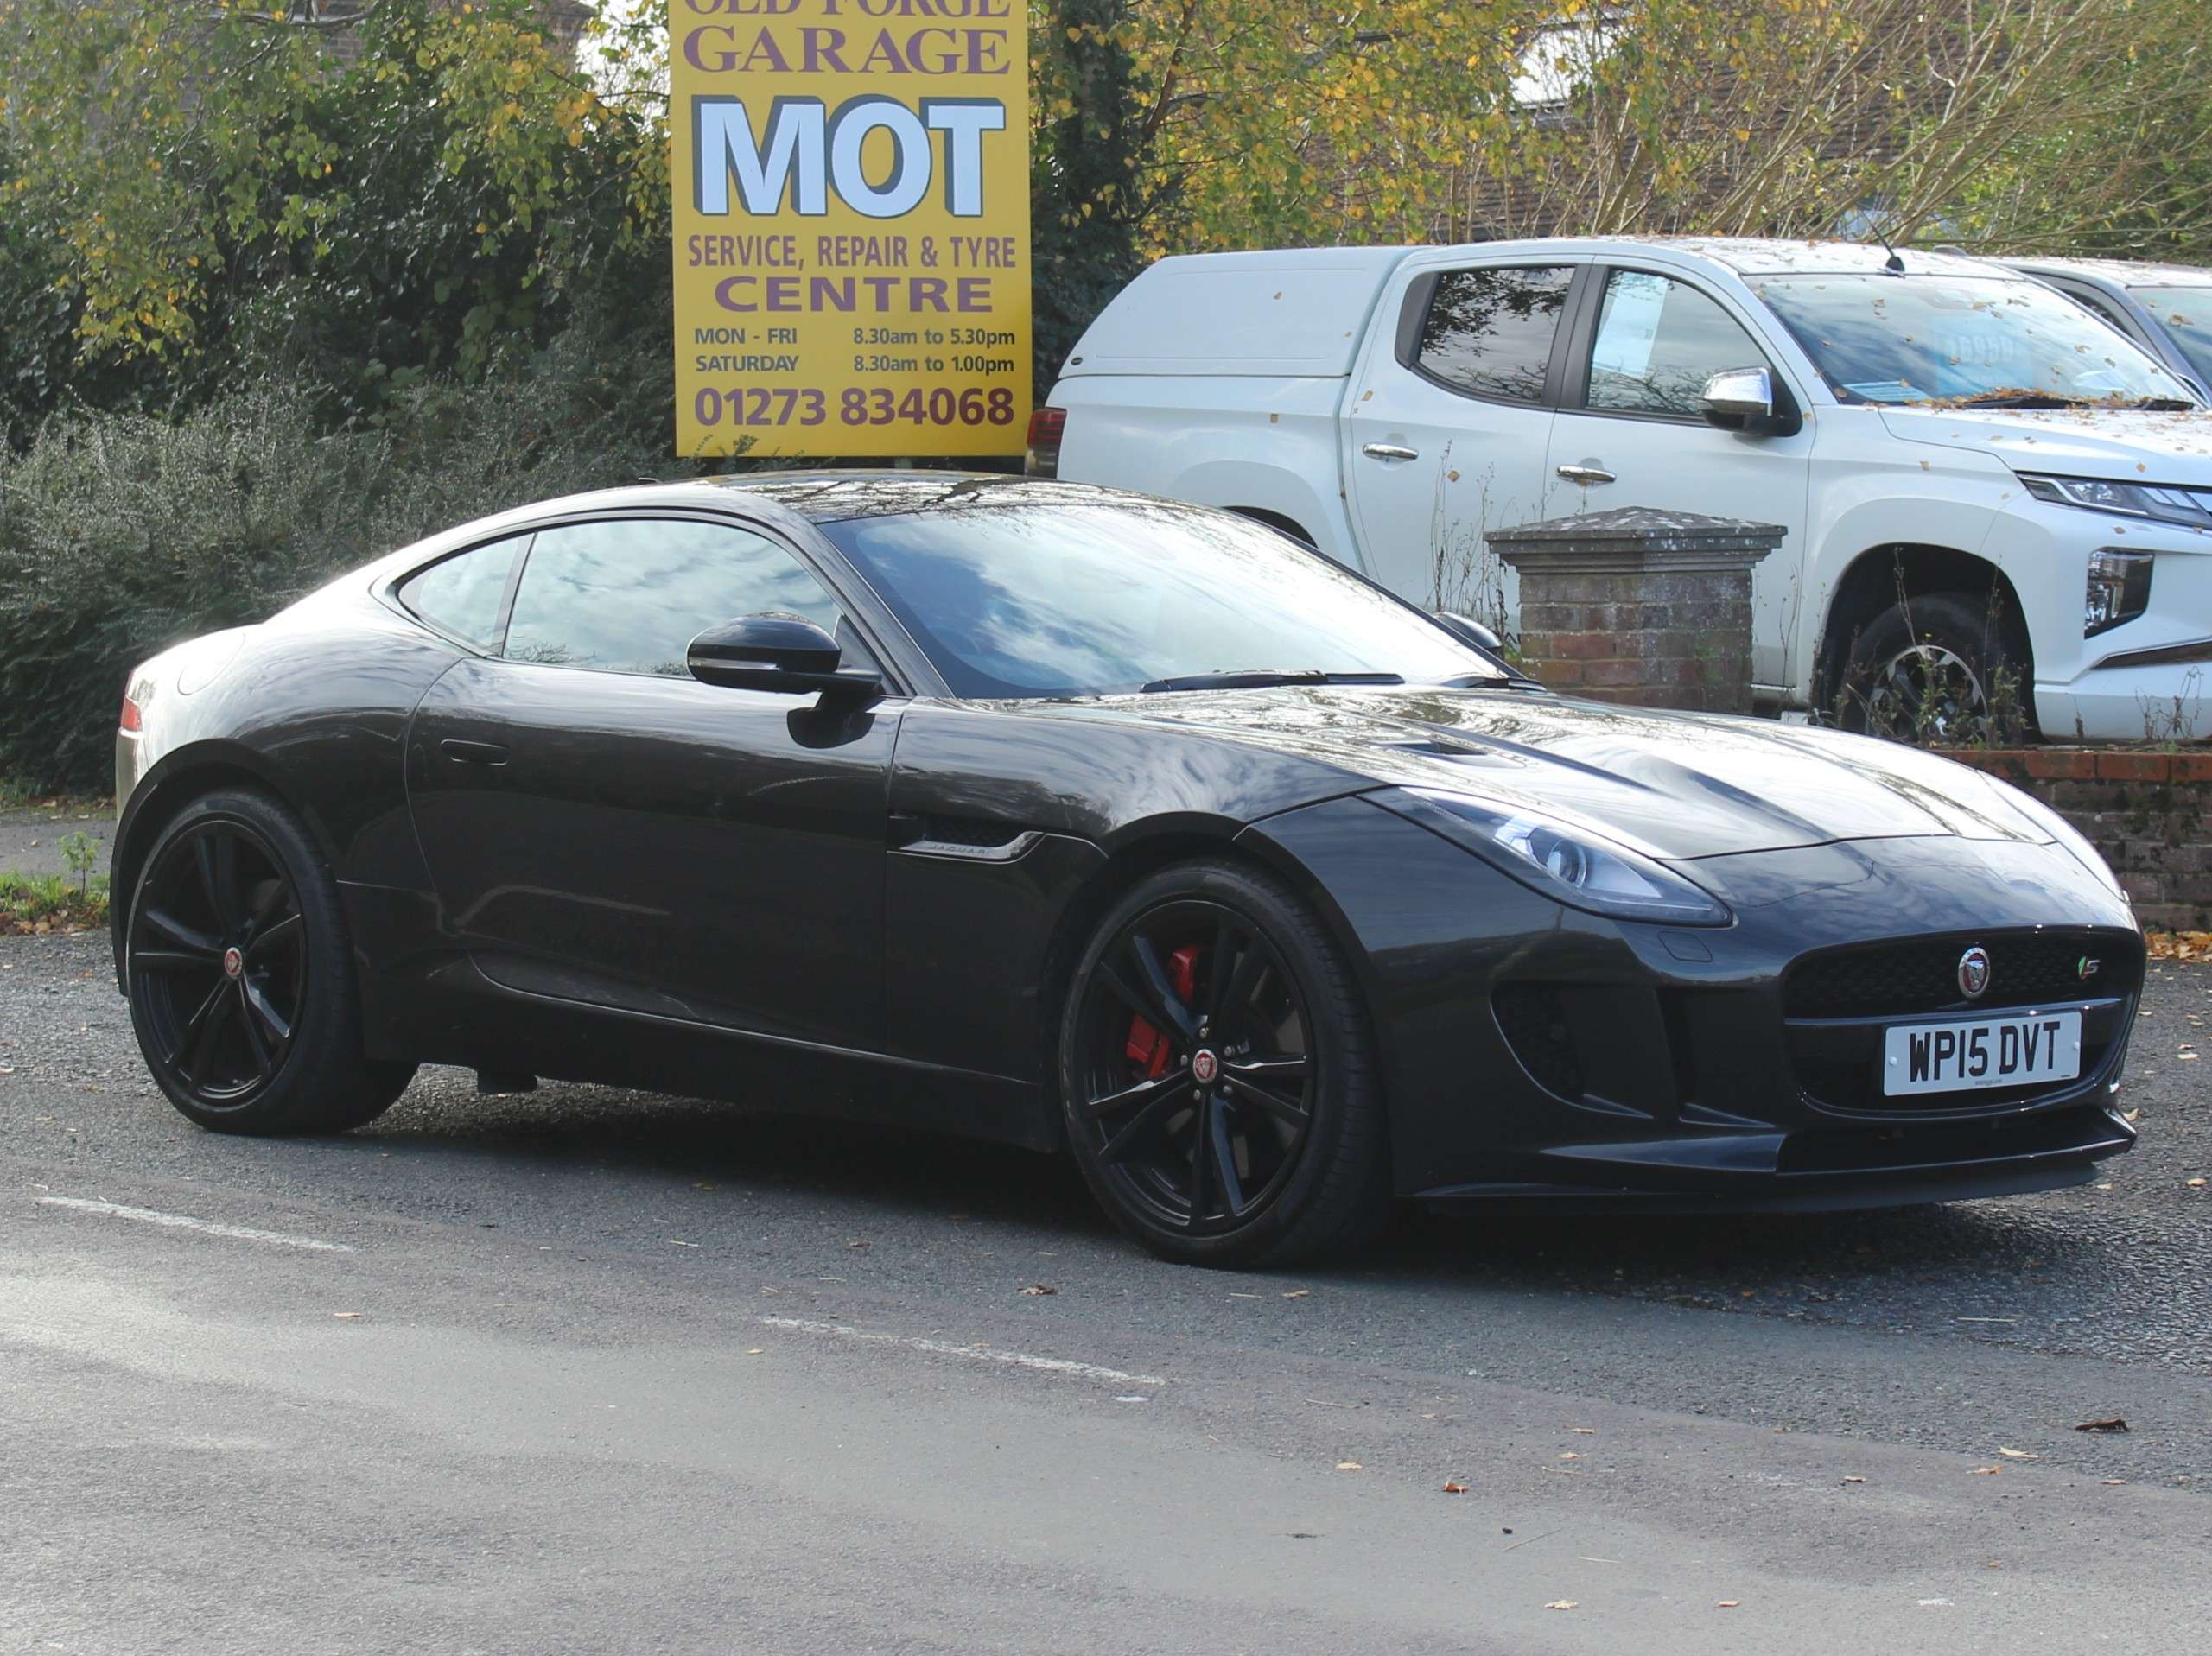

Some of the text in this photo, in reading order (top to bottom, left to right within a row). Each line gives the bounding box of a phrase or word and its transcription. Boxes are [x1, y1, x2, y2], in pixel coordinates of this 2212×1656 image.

[683, 25, 1011, 74] GARAGE
[691, 93, 1006, 219] MOT
[688, 235, 1016, 270] SERVICE, REPAIR & TYRE
[715, 276, 993, 313] CENTRE
[694, 328, 746, 344] MON
[767, 328, 798, 344] FRI
[854, 328, 918, 344] 8.30am
[925, 330, 944, 344] to
[950, 328, 1015, 348] 5.30pm
[696, 355, 1014, 376] SATURDAY 8.30am to 1.00pm
[695, 388, 1014, 426] 01273 834068
[1910, 1021, 2061, 1082] WP15 DVT
